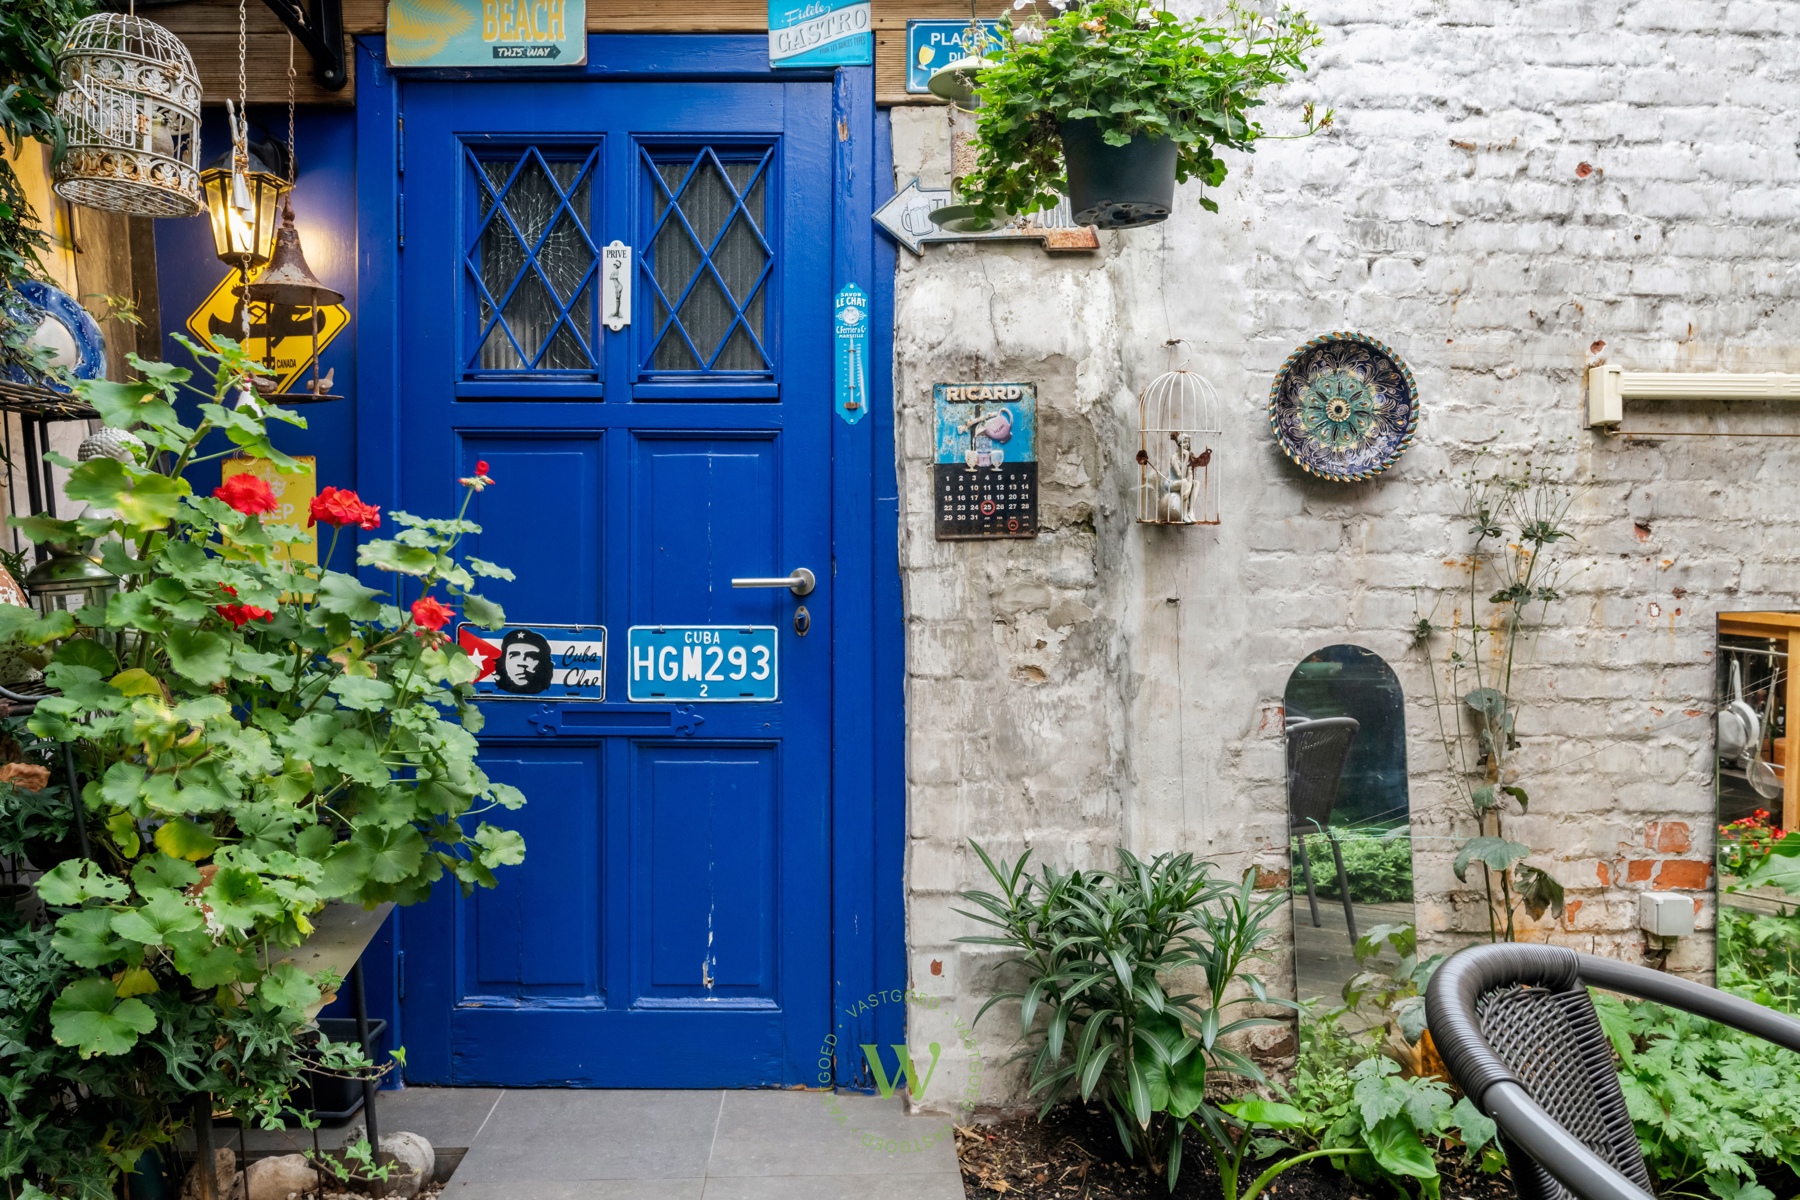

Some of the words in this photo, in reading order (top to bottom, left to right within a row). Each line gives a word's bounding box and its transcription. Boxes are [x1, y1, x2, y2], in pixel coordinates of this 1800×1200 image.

[482, 0, 566, 42] BEACH
[785, 0, 830, 29] Fidèle
[777, 8, 867, 53] GASTRO
[498, 47, 524, 57] THIS
[526, 47, 551, 57] WAY
[606, 249, 627, 259] PRIVE
[836, 297, 845, 308] LE
[846, 296, 866, 308] CHAT
[276, 359, 297, 369] CANADA
[946, 386, 1022, 403] RICARD
[684, 631, 720, 644] CUBA
[561, 645, 598, 667] Cuba
[633, 645, 770, 681] HGM293
[563, 667, 599, 688] Che
[700, 684, 709, 697] 2
